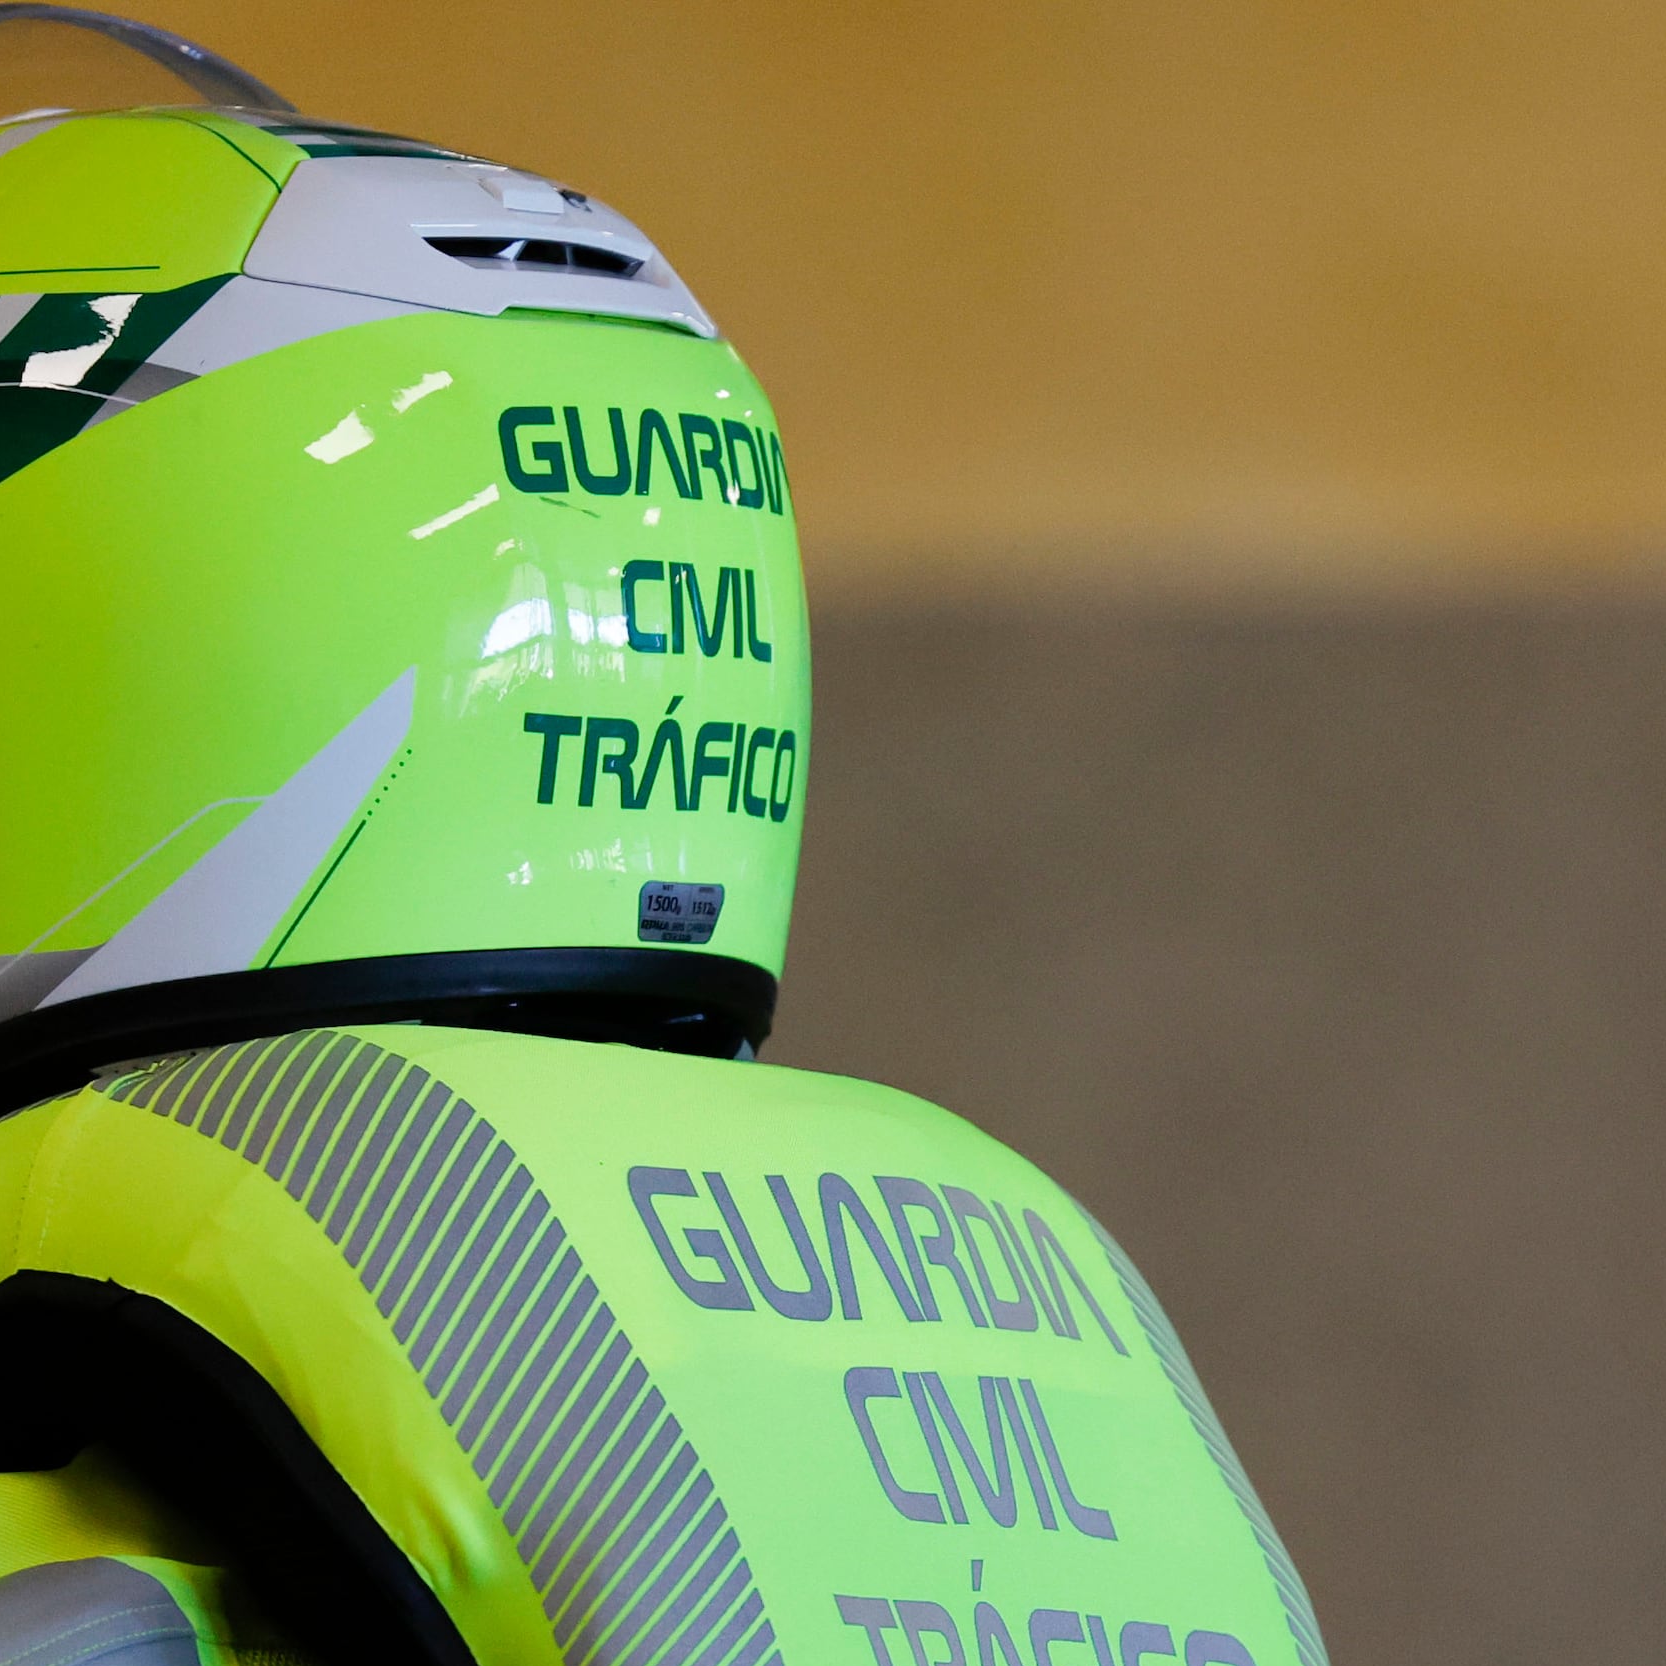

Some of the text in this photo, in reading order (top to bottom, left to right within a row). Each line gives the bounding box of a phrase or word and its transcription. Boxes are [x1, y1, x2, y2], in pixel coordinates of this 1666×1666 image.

[498, 405, 793, 516] GUARDIA
[620, 558, 773, 663] CIVIL
[523, 695, 797, 823] TRÁFICO
[626, 1165, 1132, 1358] GUARDIA
[843, 1366, 1118, 1541] CIVIL
